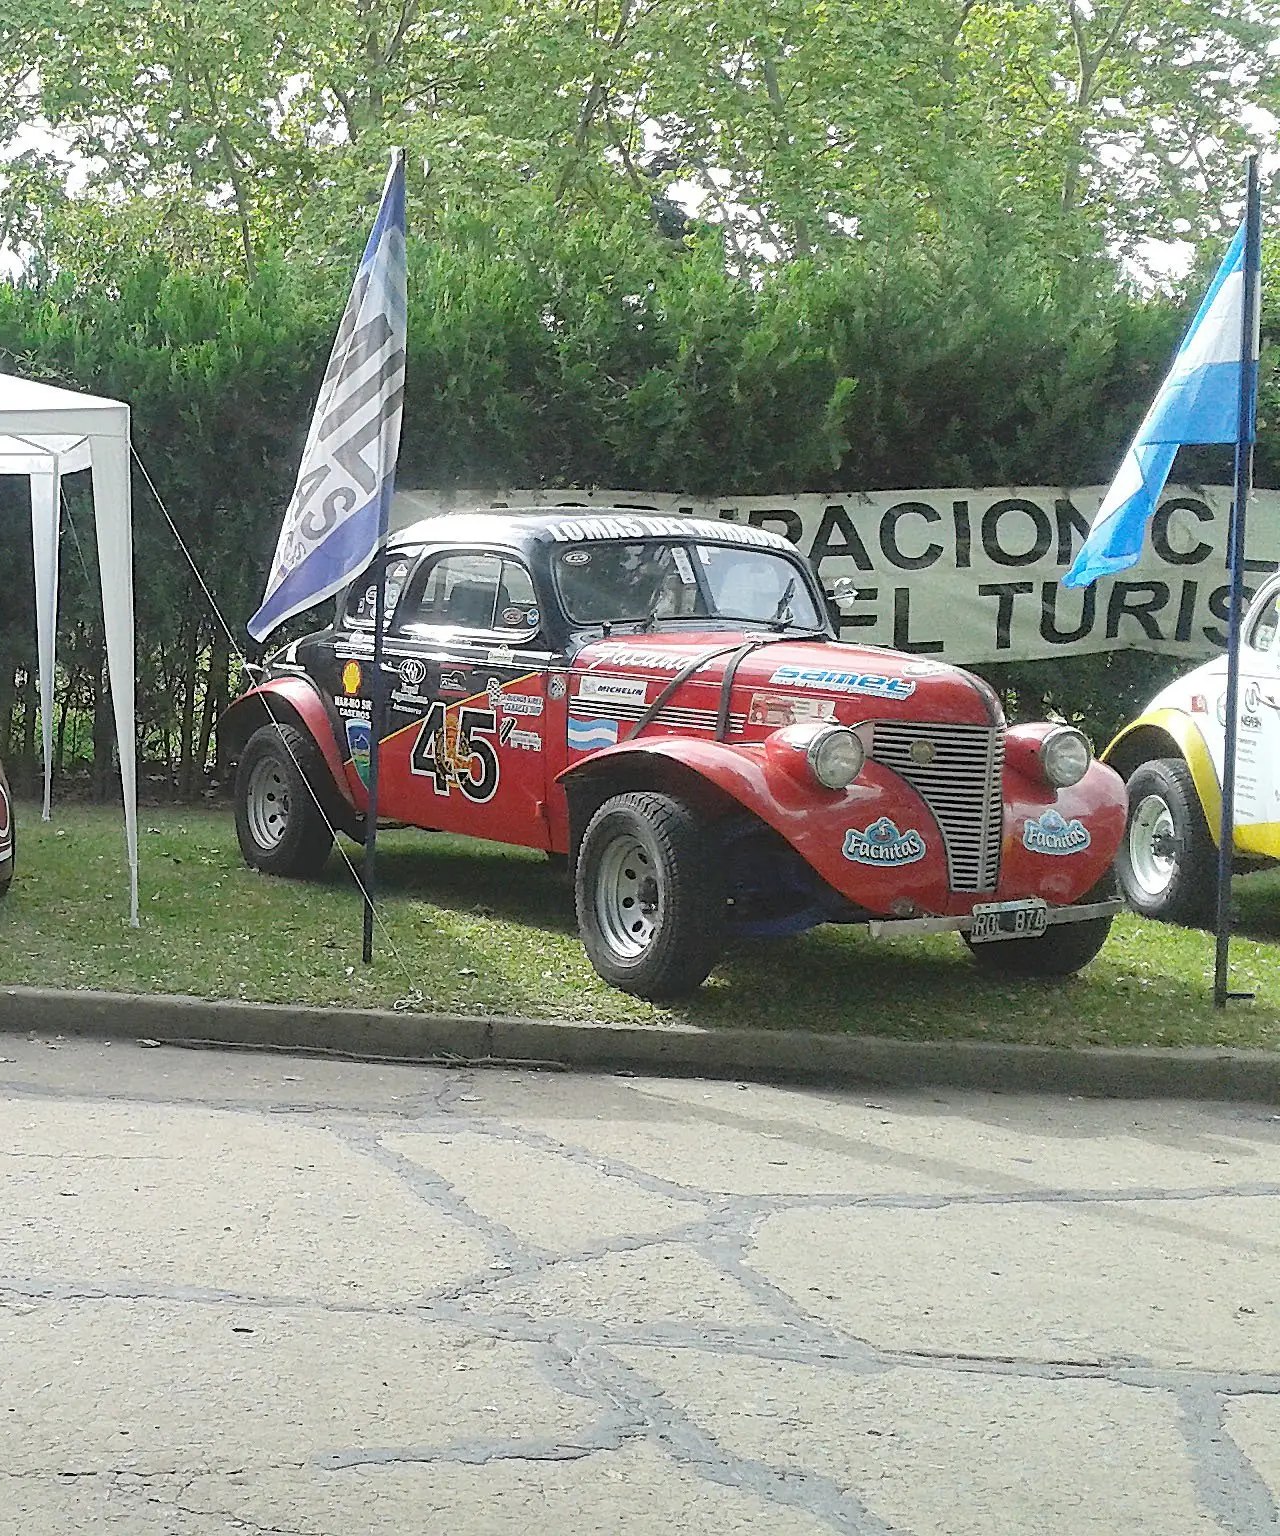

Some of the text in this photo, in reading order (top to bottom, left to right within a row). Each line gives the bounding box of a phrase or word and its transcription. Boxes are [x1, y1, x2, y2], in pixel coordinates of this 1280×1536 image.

[490, 497, 1093, 571] PACION
[545, 517, 644, 542] LOMAS
[638, 517, 694, 537] DEL
[826, 587, 945, 653] EL
[597, 684, 644, 696] MICHELIN
[410, 701, 499, 804] 45
